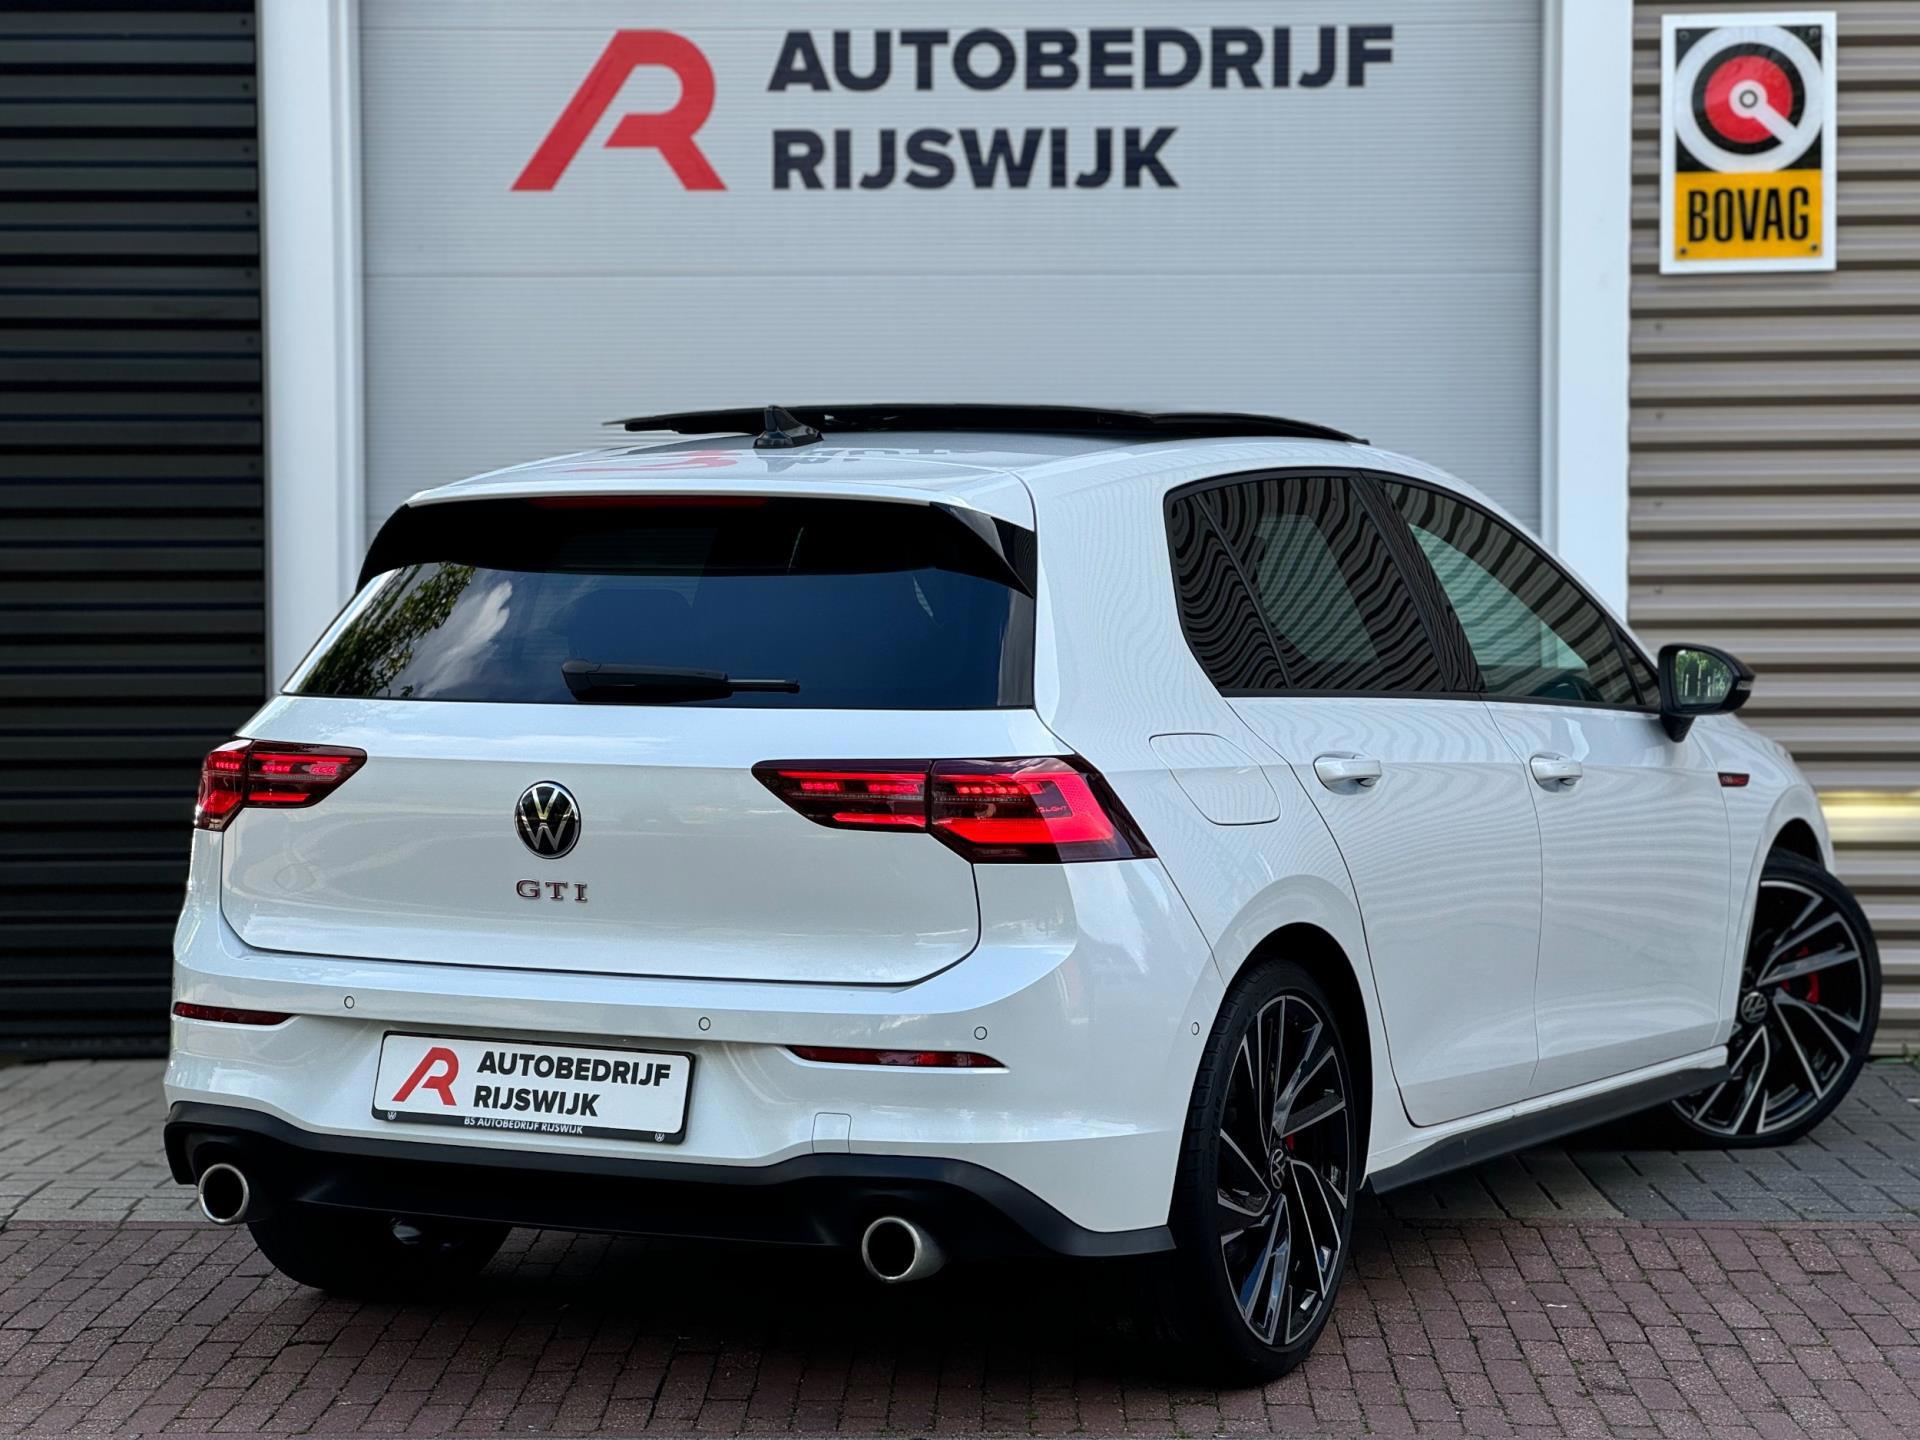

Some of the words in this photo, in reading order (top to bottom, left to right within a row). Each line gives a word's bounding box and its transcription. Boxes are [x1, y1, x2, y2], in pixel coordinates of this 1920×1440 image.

[767, 24, 1394, 92] AUTOBEDRIJF
[772, 127, 1179, 190] RIJSWIJK
[1687, 187, 1809, 243] BOVAG
[516, 879, 588, 903] GTI
[476, 1050, 672, 1087] AUTOBEDRIJF
[473, 1085, 600, 1118] RIJSWIJK
[477, 1117, 540, 1131] AUTOBEDRIJF
[541, 1122, 583, 1135] RIJSWIJK
